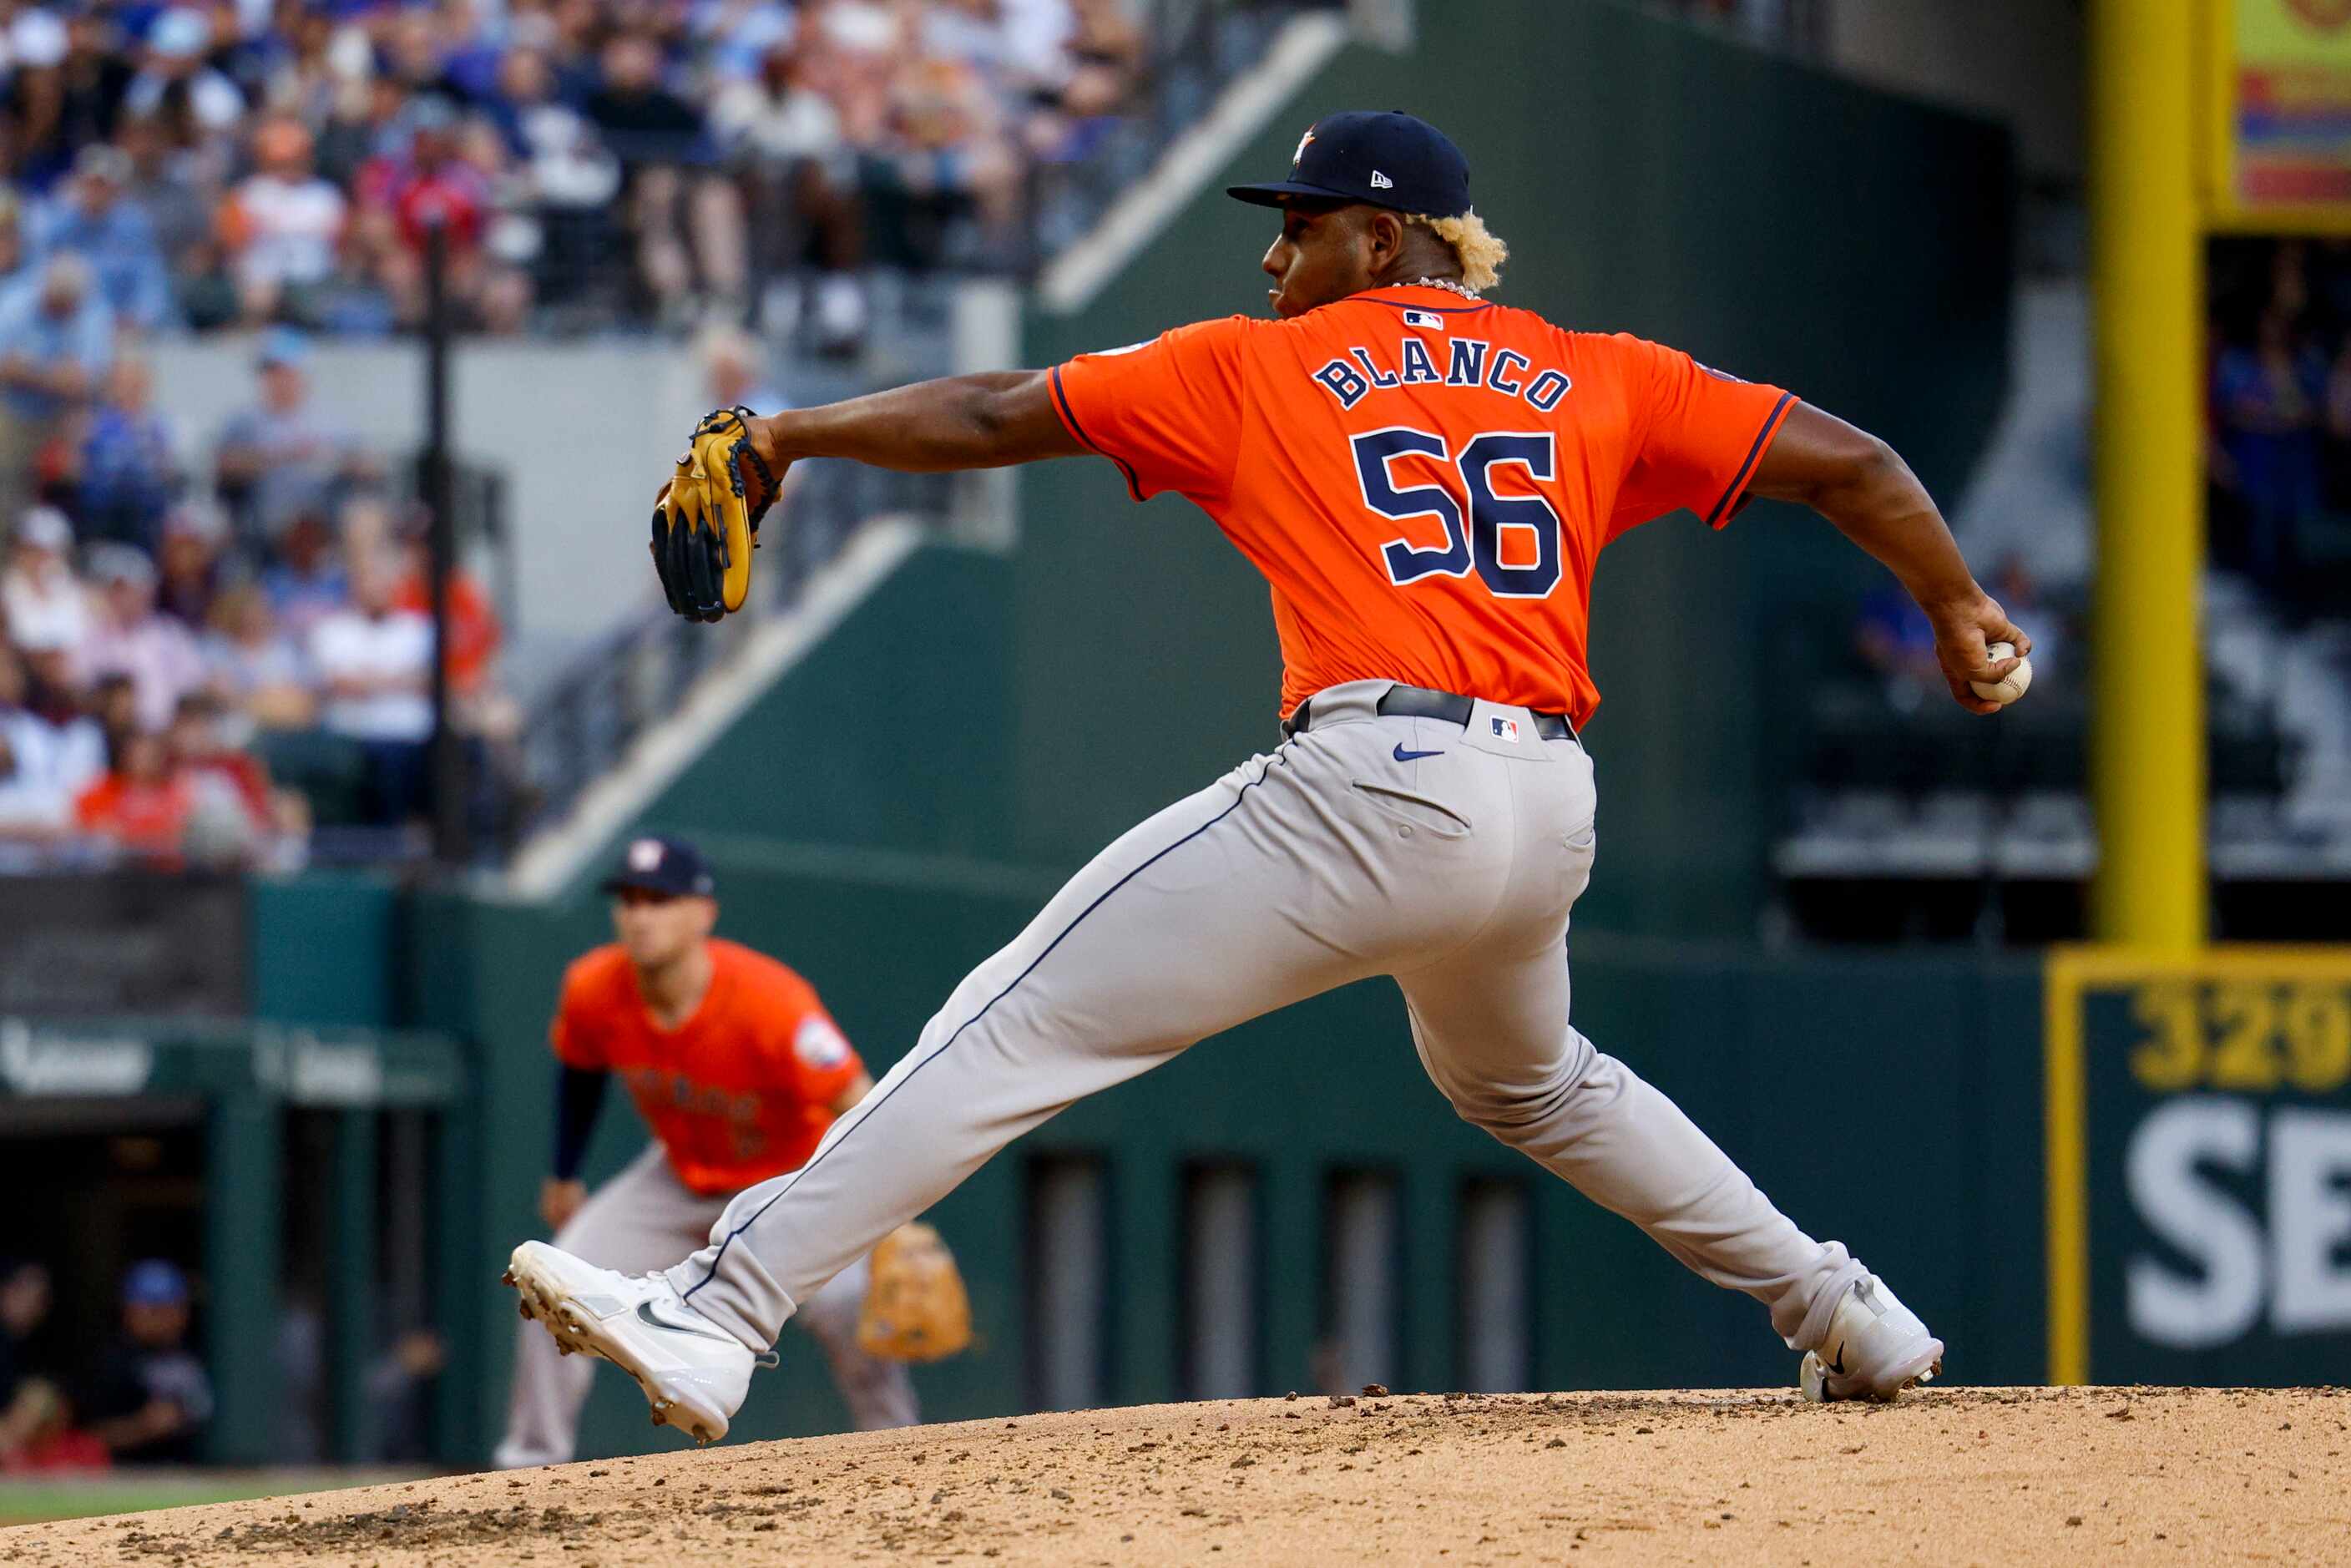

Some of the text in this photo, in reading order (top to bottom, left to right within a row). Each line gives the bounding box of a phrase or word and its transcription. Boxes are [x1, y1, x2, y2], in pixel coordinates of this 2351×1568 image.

[1312, 337, 1572, 412] BLANCO
[1348, 426, 1563, 599] 56
[2125, 1094, 2351, 1348] SE
